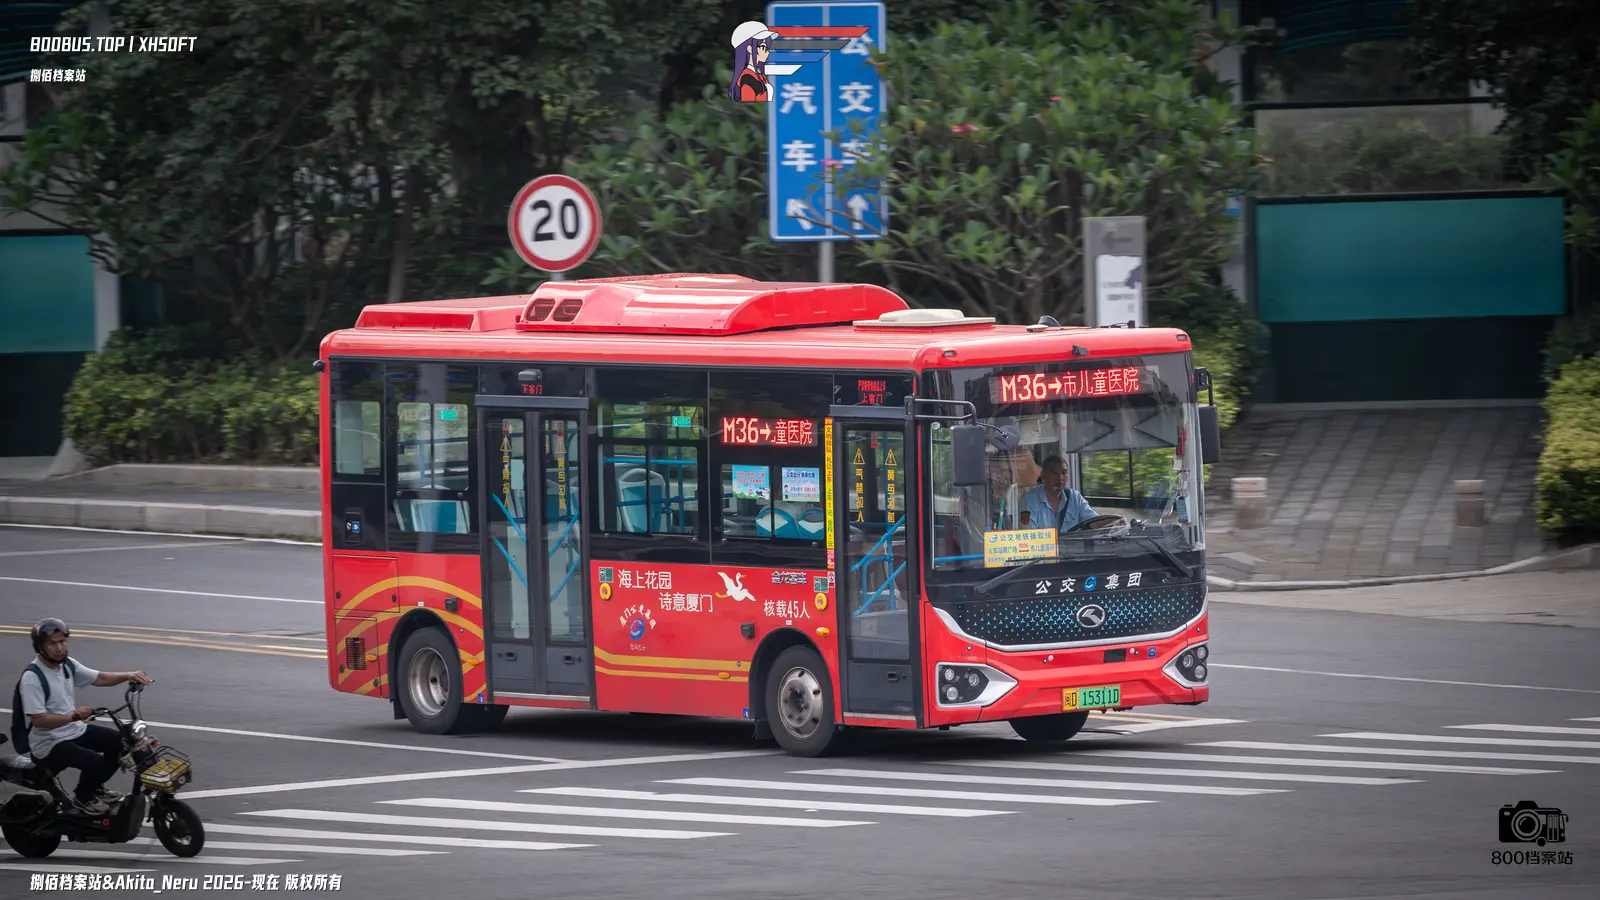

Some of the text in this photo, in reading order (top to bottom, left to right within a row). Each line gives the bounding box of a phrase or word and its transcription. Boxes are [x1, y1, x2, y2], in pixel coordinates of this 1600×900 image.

[530, 198, 579, 242] 20
[1001, 366, 1140, 402] M36 市儿童医院
[722, 416, 813, 445] M36 童医院
[617, 569, 673, 590] 海上花园
[771, 570, 807, 585] 金龙客车
[1035, 572, 1142, 595] 公交 集团
[658, 592, 714, 613] 诗意厦门
[764, 599, 810, 619] 核载45人
[1082, 688, 1119, 707] 15311D
